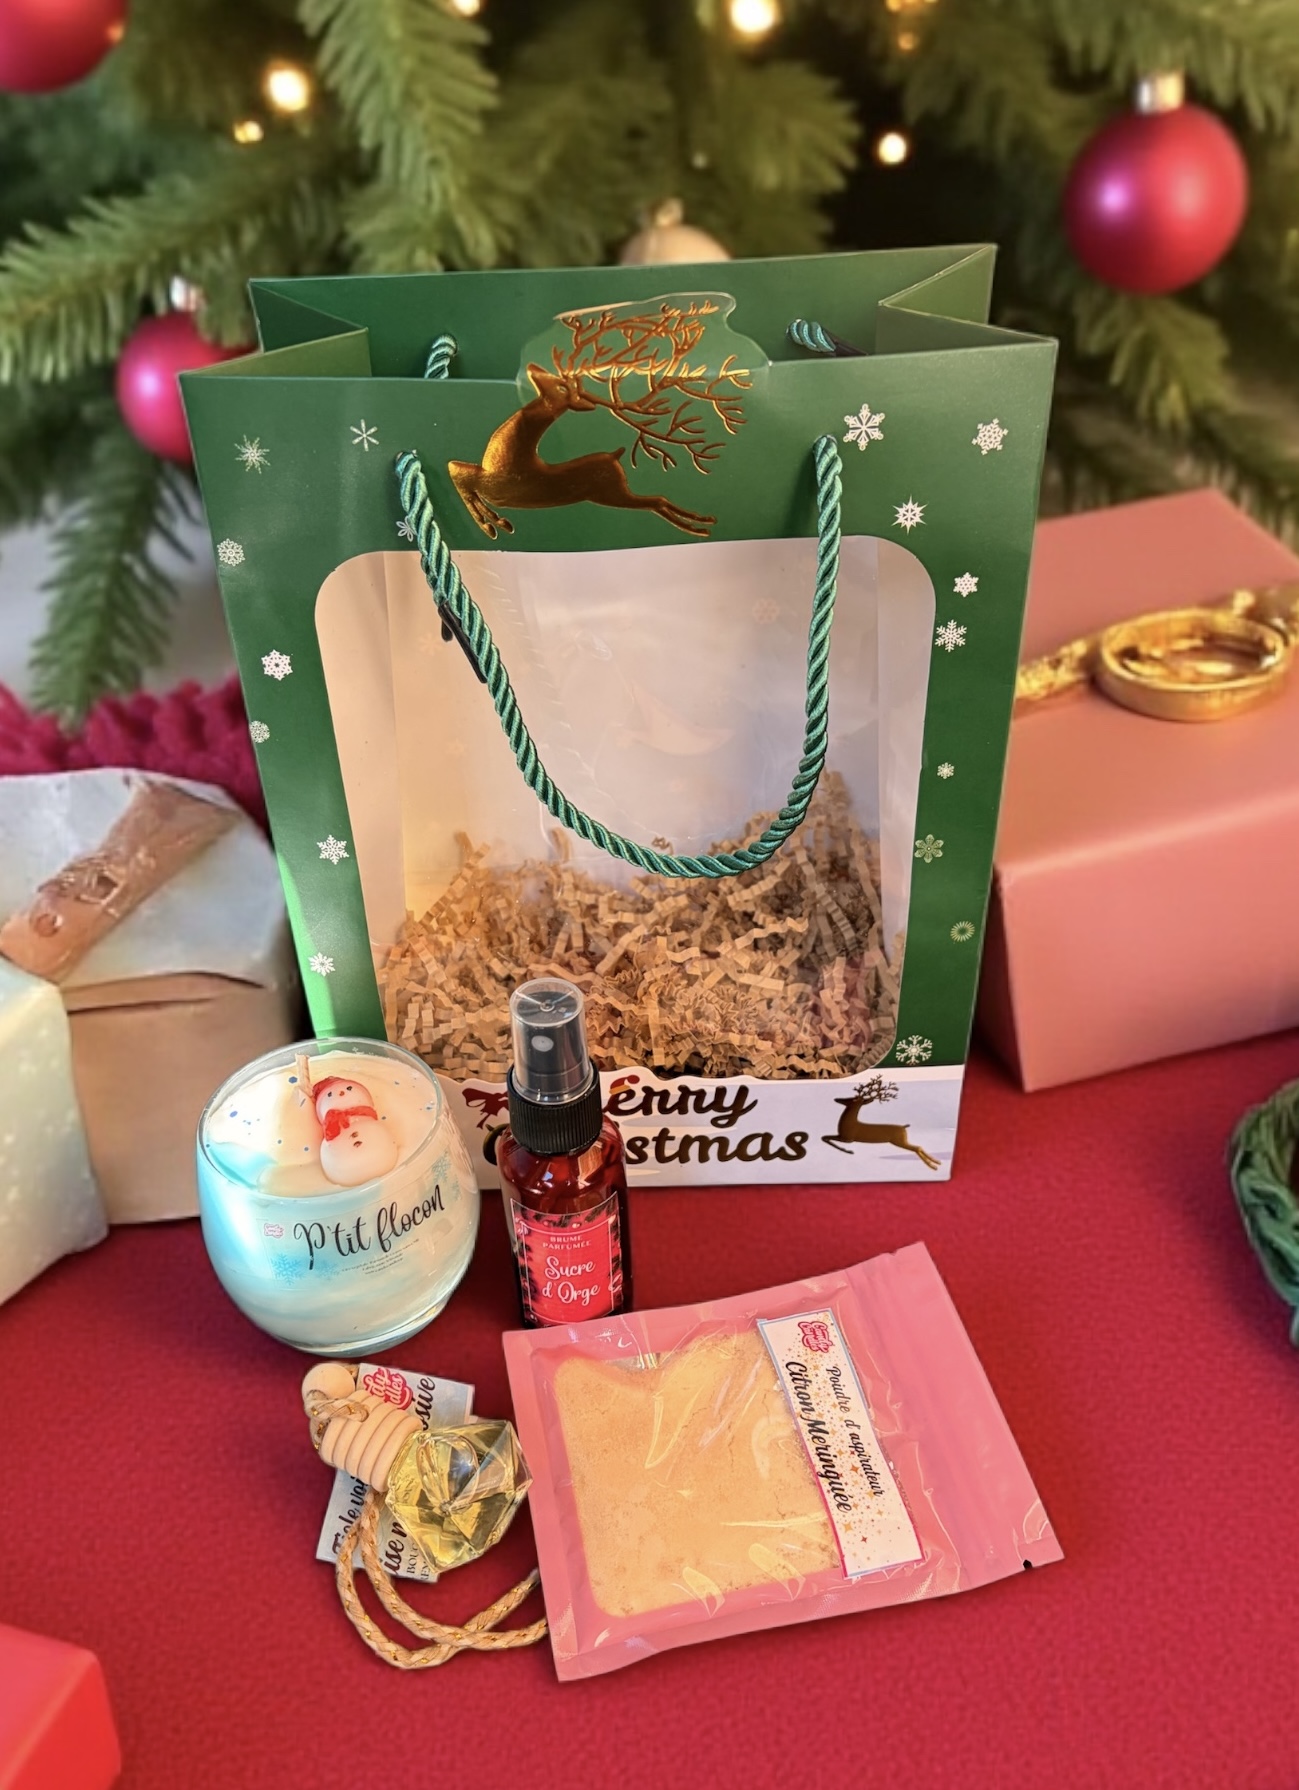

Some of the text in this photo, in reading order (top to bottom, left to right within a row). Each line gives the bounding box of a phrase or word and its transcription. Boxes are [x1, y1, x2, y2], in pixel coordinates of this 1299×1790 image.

[602, 1085, 758, 1129] erry
[293, 1216, 371, 1270] P'tit
[377, 1184, 444, 1253] flocon
[549, 1235, 582, 1243] BRUME
[545, 1256, 595, 1280] Sucre
[542, 1281, 601, 1306] d'Orge
[826, 1367, 851, 1413] Poudre
[785, 1361, 852, 1513] Citron Meringuée
